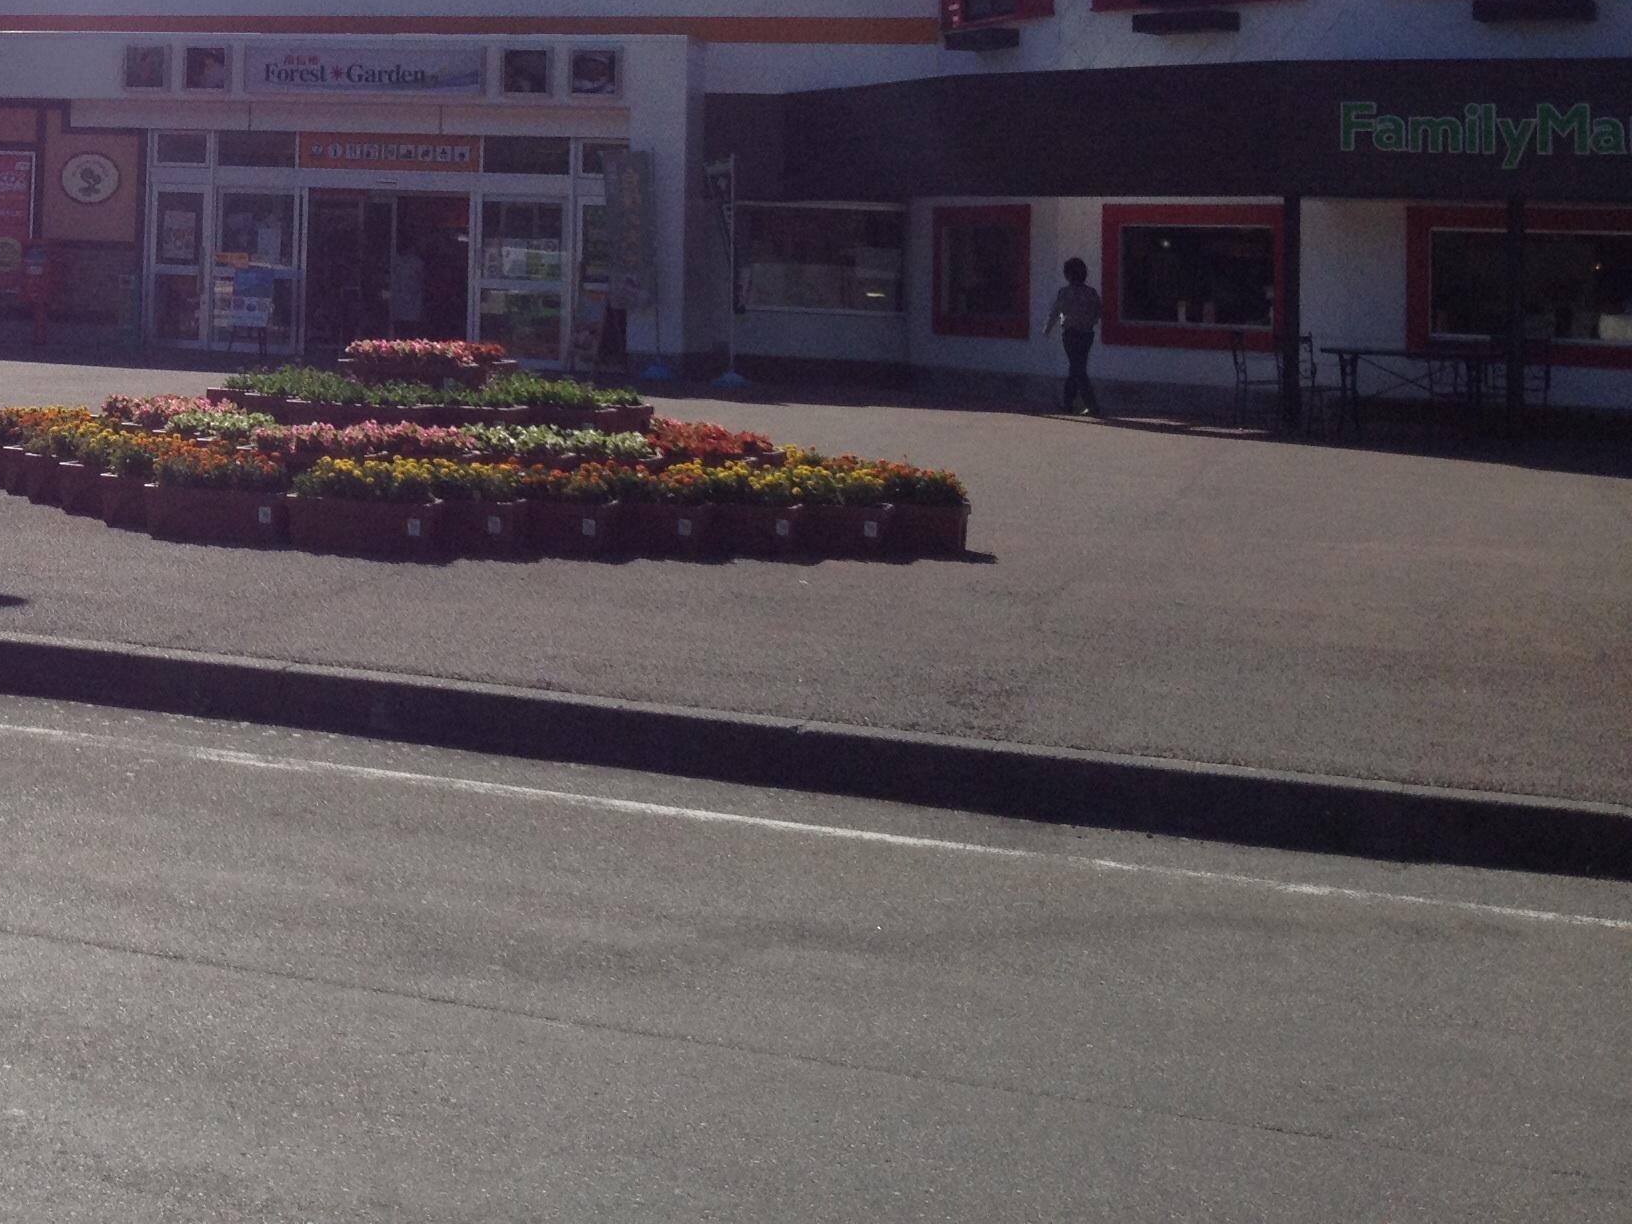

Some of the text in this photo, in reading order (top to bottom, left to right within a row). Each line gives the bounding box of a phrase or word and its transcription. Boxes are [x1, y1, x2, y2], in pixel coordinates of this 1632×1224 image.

[264, 62, 427, 84] Forest Garden
[1339, 101, 1632, 170] FamilyMa
